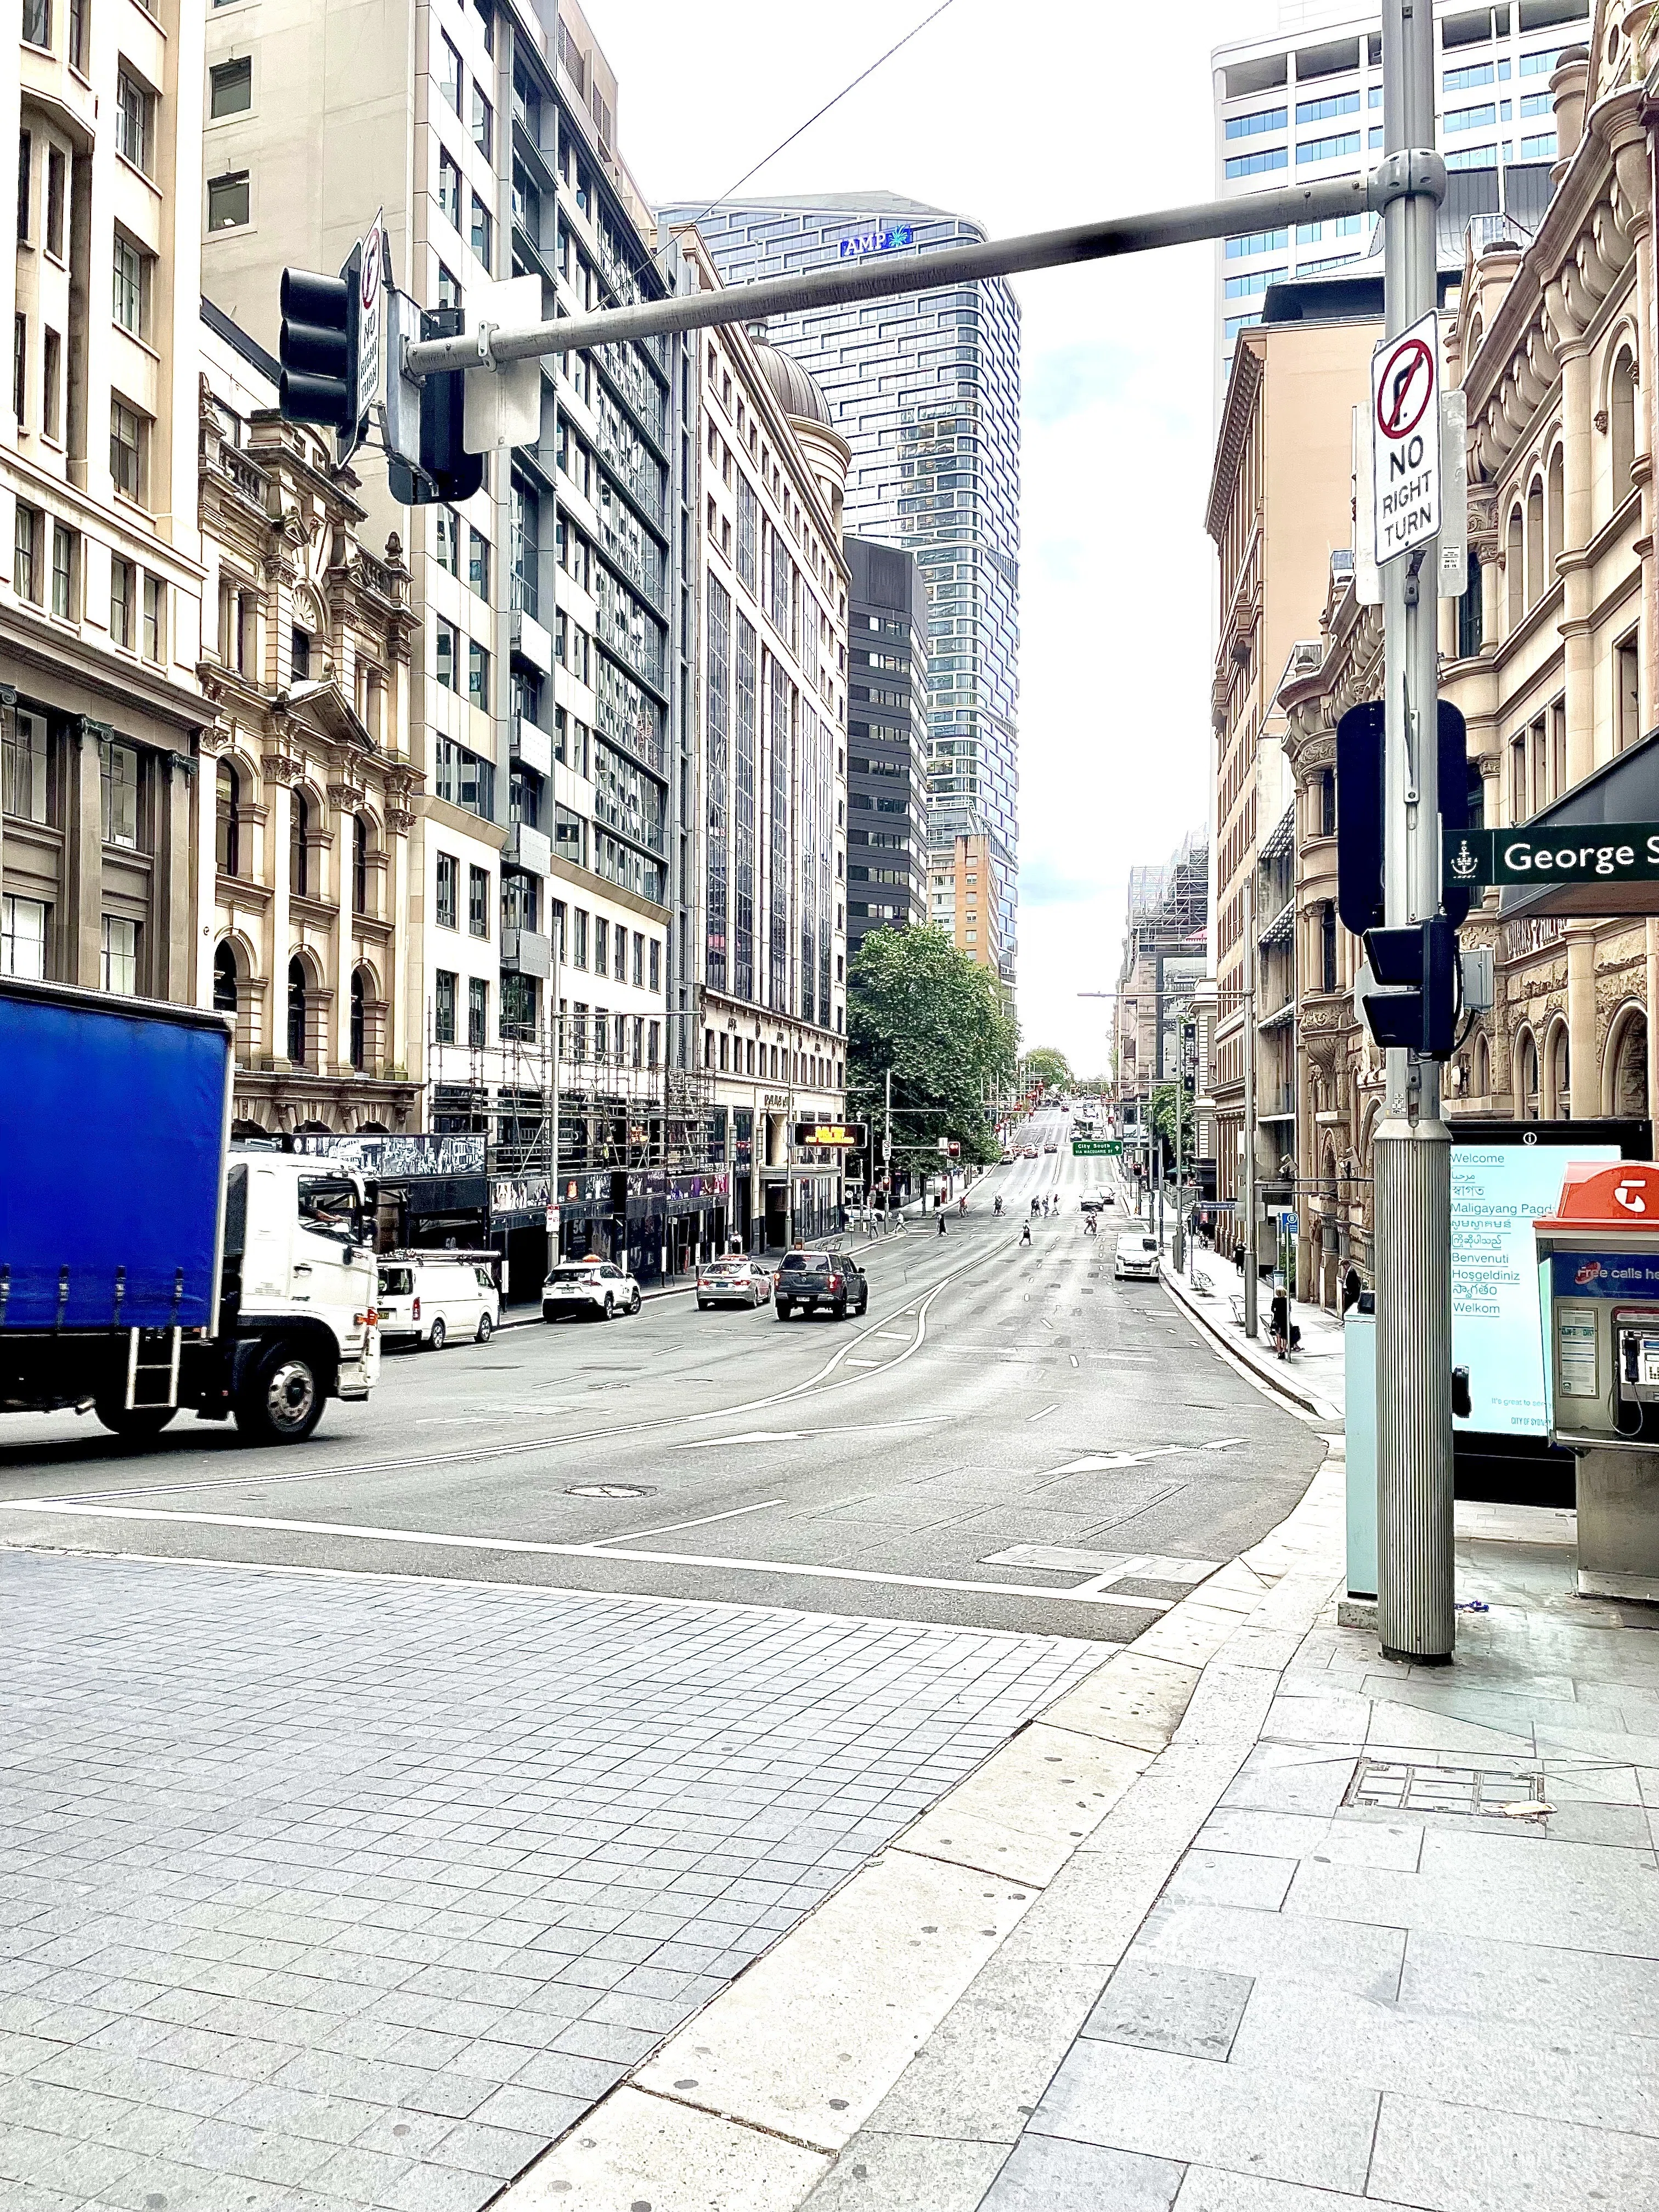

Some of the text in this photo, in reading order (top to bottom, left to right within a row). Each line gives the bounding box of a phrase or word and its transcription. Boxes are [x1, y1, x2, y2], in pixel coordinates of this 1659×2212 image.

[844, 233, 887, 256] AMP
[364, 309, 376, 349] NO
[360, 336, 377, 379] RIGHT
[361, 363, 377, 402] TURN
[1390, 435, 1424, 482] NO
[1383, 470, 1432, 518] RIGHT
[1384, 503, 1431, 546] TURN
[1504, 842, 1634, 874] George
[1451, 1153, 1504, 1163] Welcome
[1451, 1203, 1517, 1216] Maligayang
[1452, 1252, 1509, 1263] Benvenuti
[1452, 1269, 1520, 1282] Hoşgeldiniz
[1577, 1266, 1609, 1278] Free
[1611, 1267, 1642, 1279] calls
[1453, 1302, 1500, 1313] Welkom
[1511, 1417, 1522, 1425] CITY
